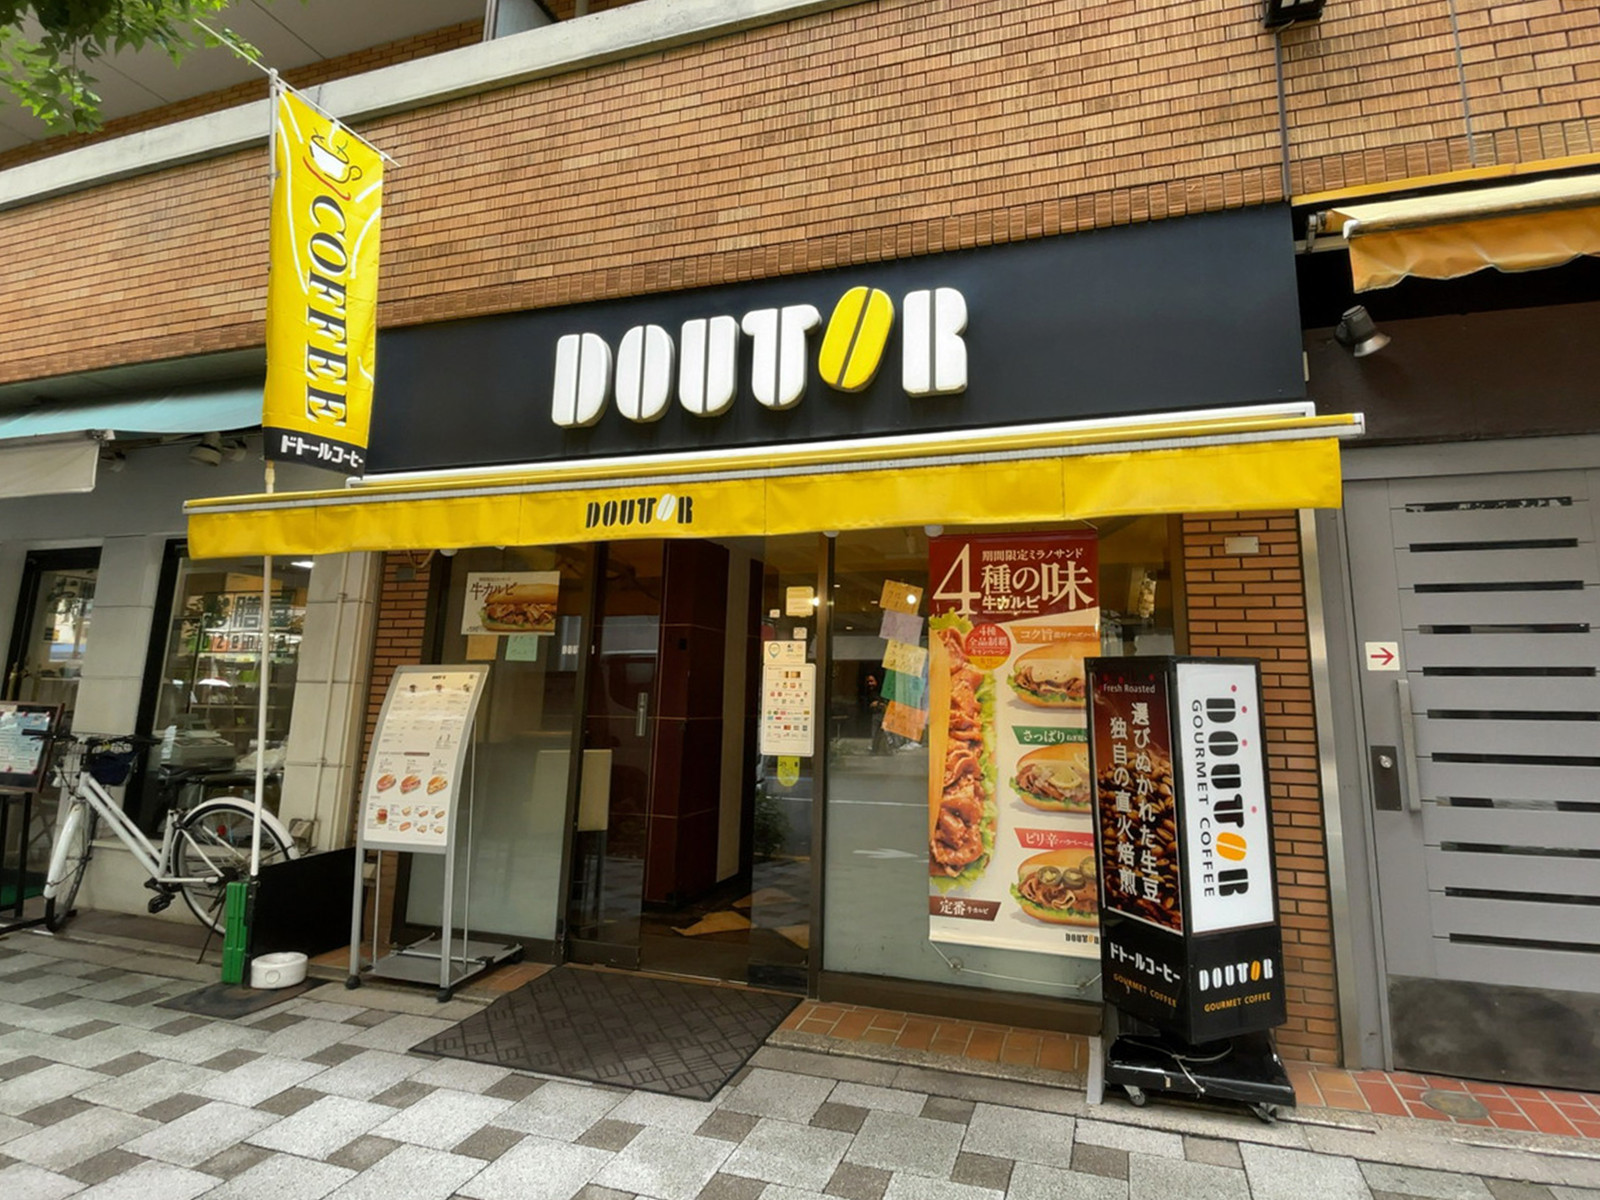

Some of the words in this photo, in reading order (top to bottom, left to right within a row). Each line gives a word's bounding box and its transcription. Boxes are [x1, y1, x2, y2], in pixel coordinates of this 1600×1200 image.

[305, 195, 347, 428] COFFEE
[552, 286, 968, 428] DOUTOR
[281, 434, 364, 468] ドトールコーヒー
[585, 494, 692, 528] DOUTOR
[982, 548, 1083, 562] 期間限定ミラノサンド
[469, 582, 518, 600] 牛カルビ
[982, 595, 1040, 610] 牛カルビ
[1103, 683, 1122, 693] Fresh
[1124, 684, 1156, 694] Roasted
[1023, 729, 1065, 743] さっぱり
[1191, 699, 1210, 806] GOURMET
[1110, 716, 1138, 896] 独自の直火焙煎
[1131, 702, 1161, 904] 選びぬかれた生豆
[1206, 698, 1249, 897] DOUTOR
[1025, 832, 1058, 848] ピリ辛
[1199, 817, 1215, 897] COFFEE
[939, 899, 966, 916] 定番
[1110, 942, 1181, 983] ドトールコーヒー
[1199, 958, 1273, 992] DOUTOR
[1113, 973, 1148, 994] GOURMET
[1149, 989, 1177, 1008] COFFEE
[1204, 997, 1242, 1013] GOURMET
[1244, 992, 1271, 1005] COFFEE
